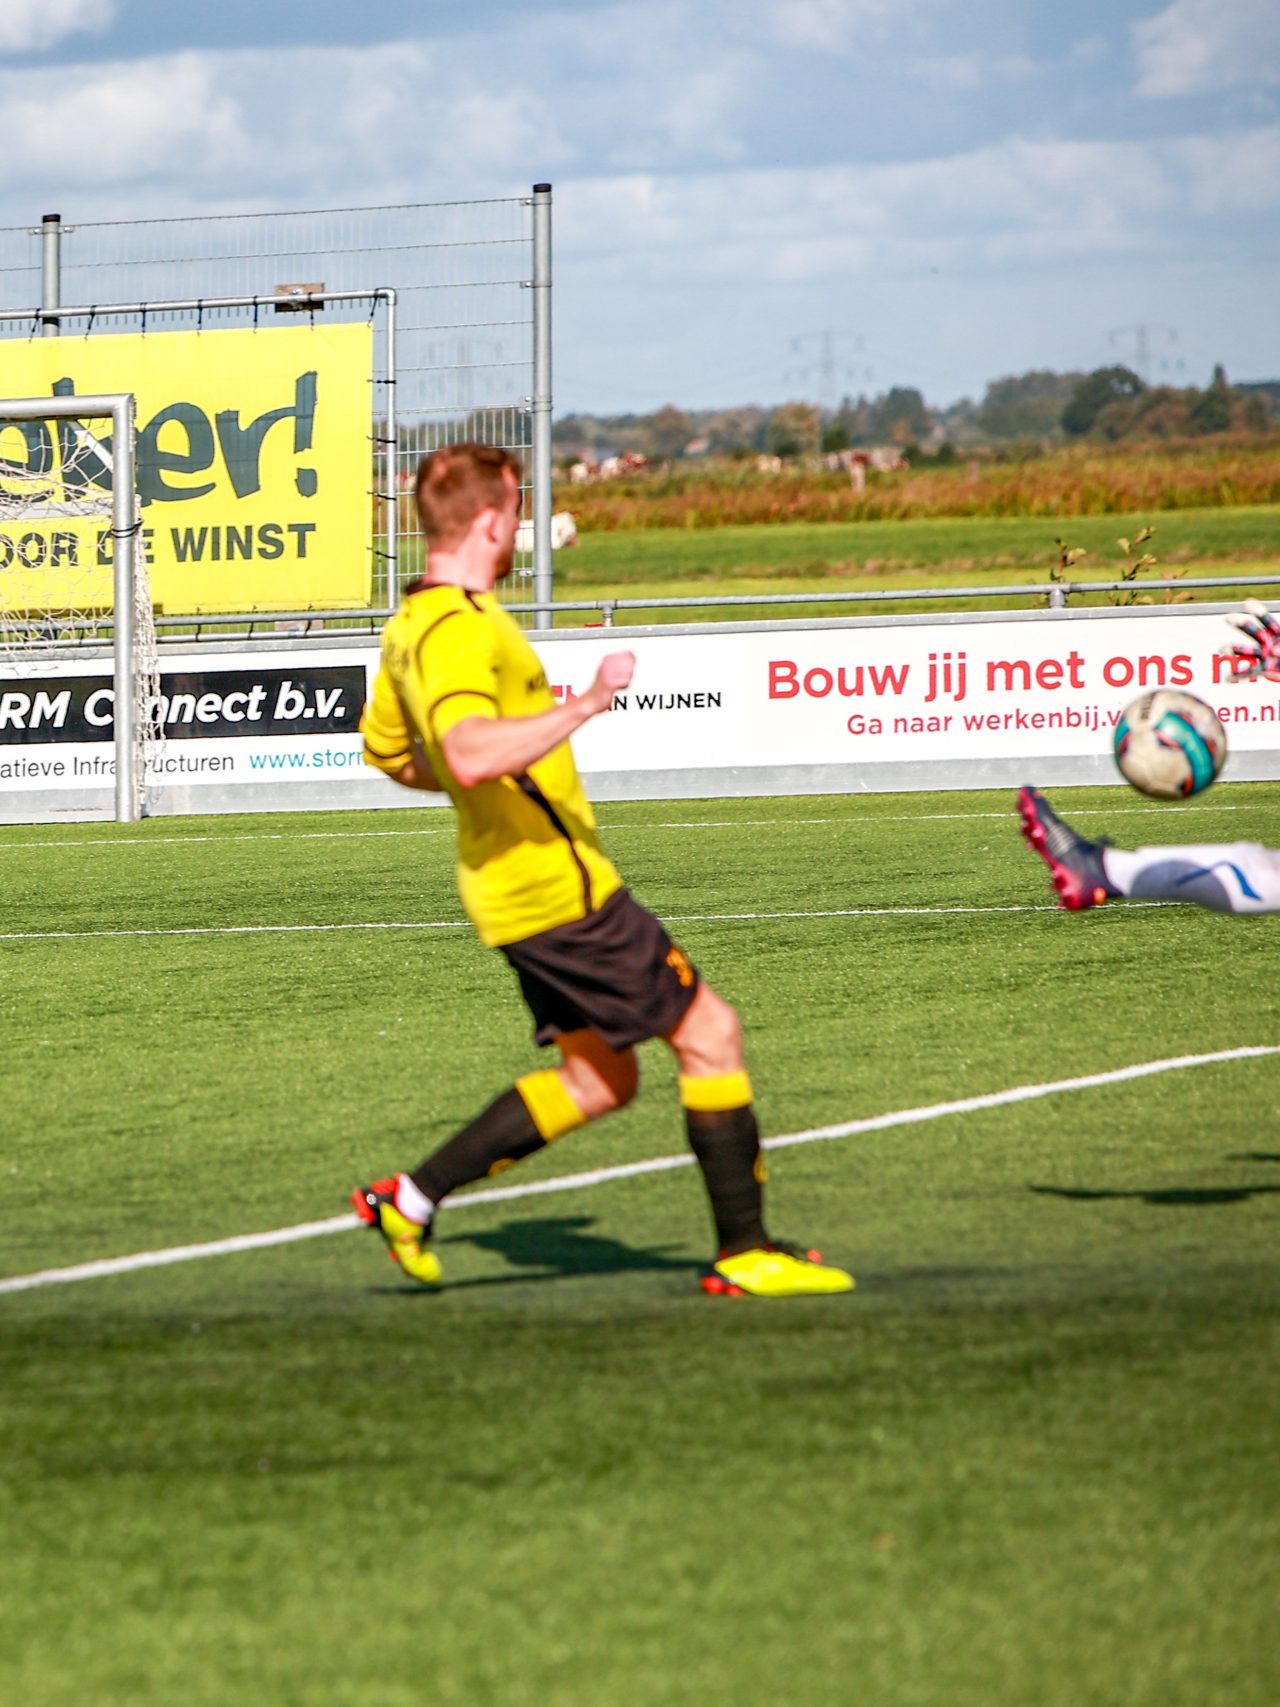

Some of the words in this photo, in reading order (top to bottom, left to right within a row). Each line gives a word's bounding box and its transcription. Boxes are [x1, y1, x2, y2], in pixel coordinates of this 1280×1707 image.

[170, 522, 317, 563] WINST
[768, 660, 910, 699] Bouw
[924, 651, 967, 702] jij
[986, 651, 1085, 691] met
[1103, 654, 1194, 687] ons
[83, 685, 267, 727] Cnnect
[273, 680, 346, 721] b.v.
[635, 692, 721, 710] WIJNEN
[847, 714, 883, 735] Ga
[893, 715, 954, 734] naar
